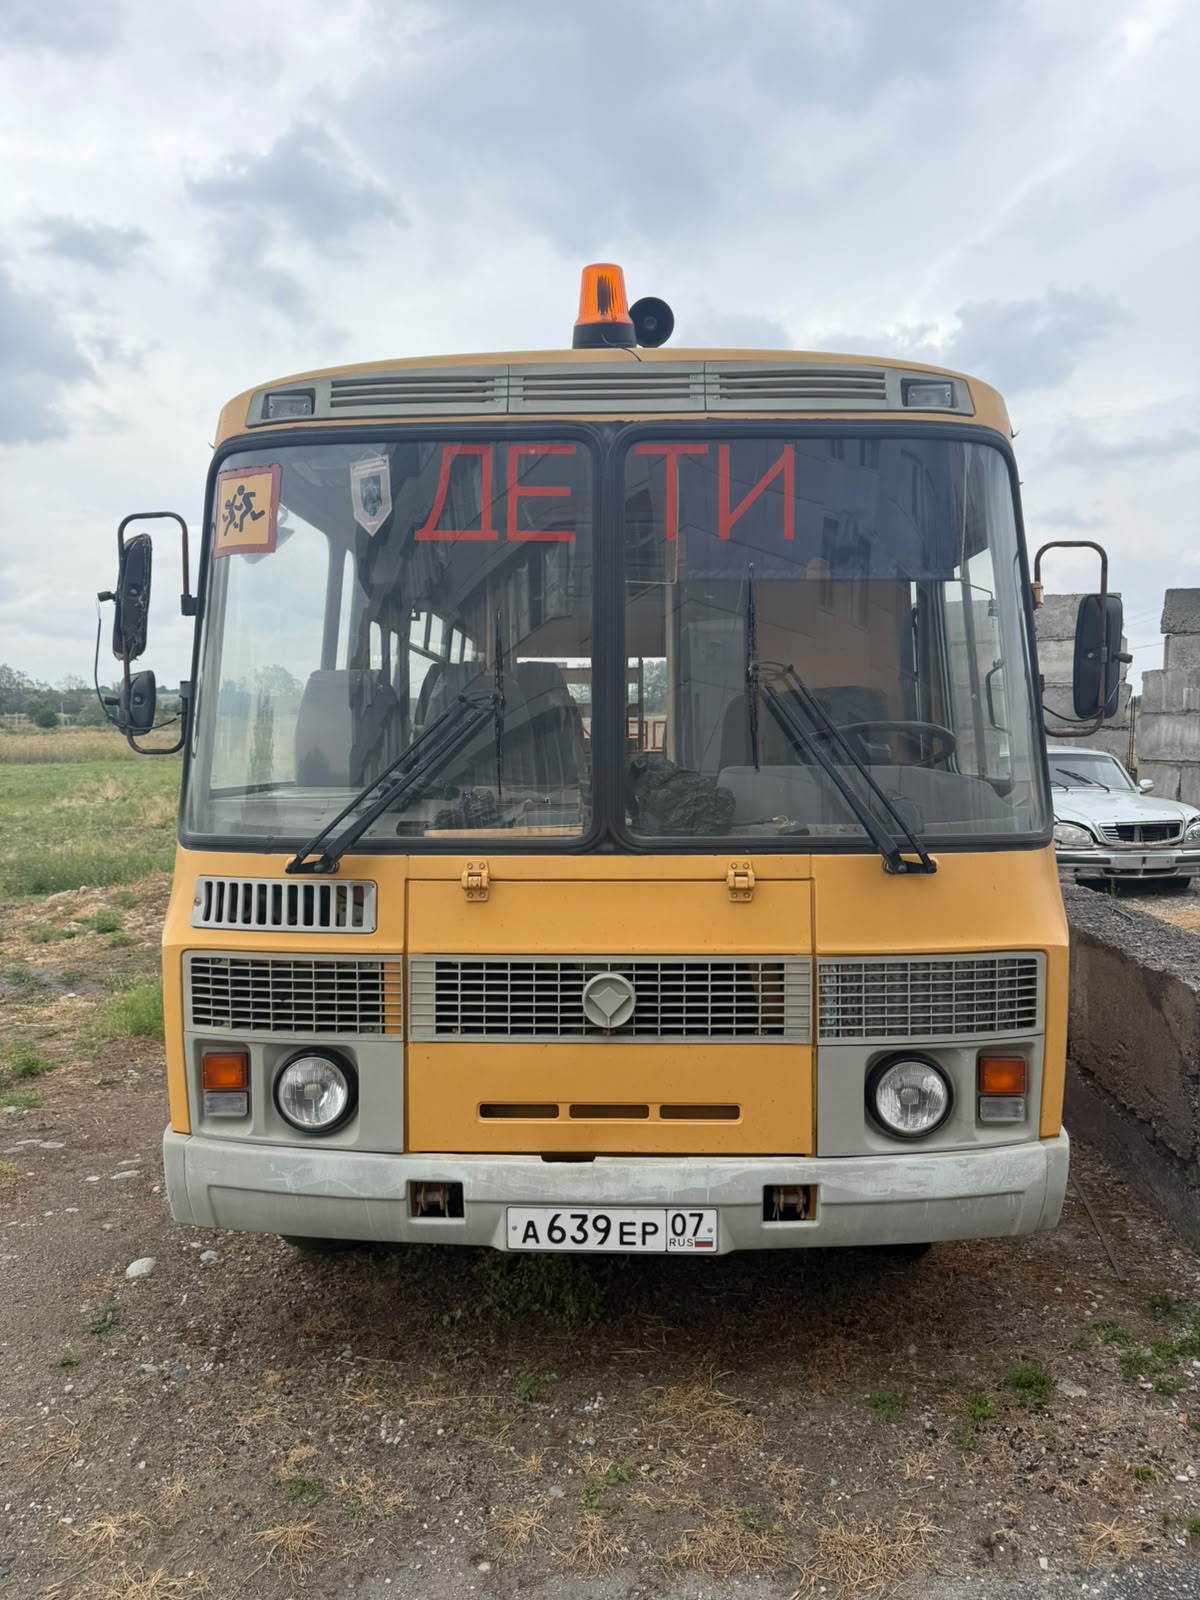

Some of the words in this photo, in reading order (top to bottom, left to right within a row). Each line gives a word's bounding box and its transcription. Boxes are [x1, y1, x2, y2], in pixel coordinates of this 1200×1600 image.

[521, 1213, 659, 1246] А639ЕР
[671, 1212, 704, 1237] 07
[669, 1238, 694, 1247] RUS
